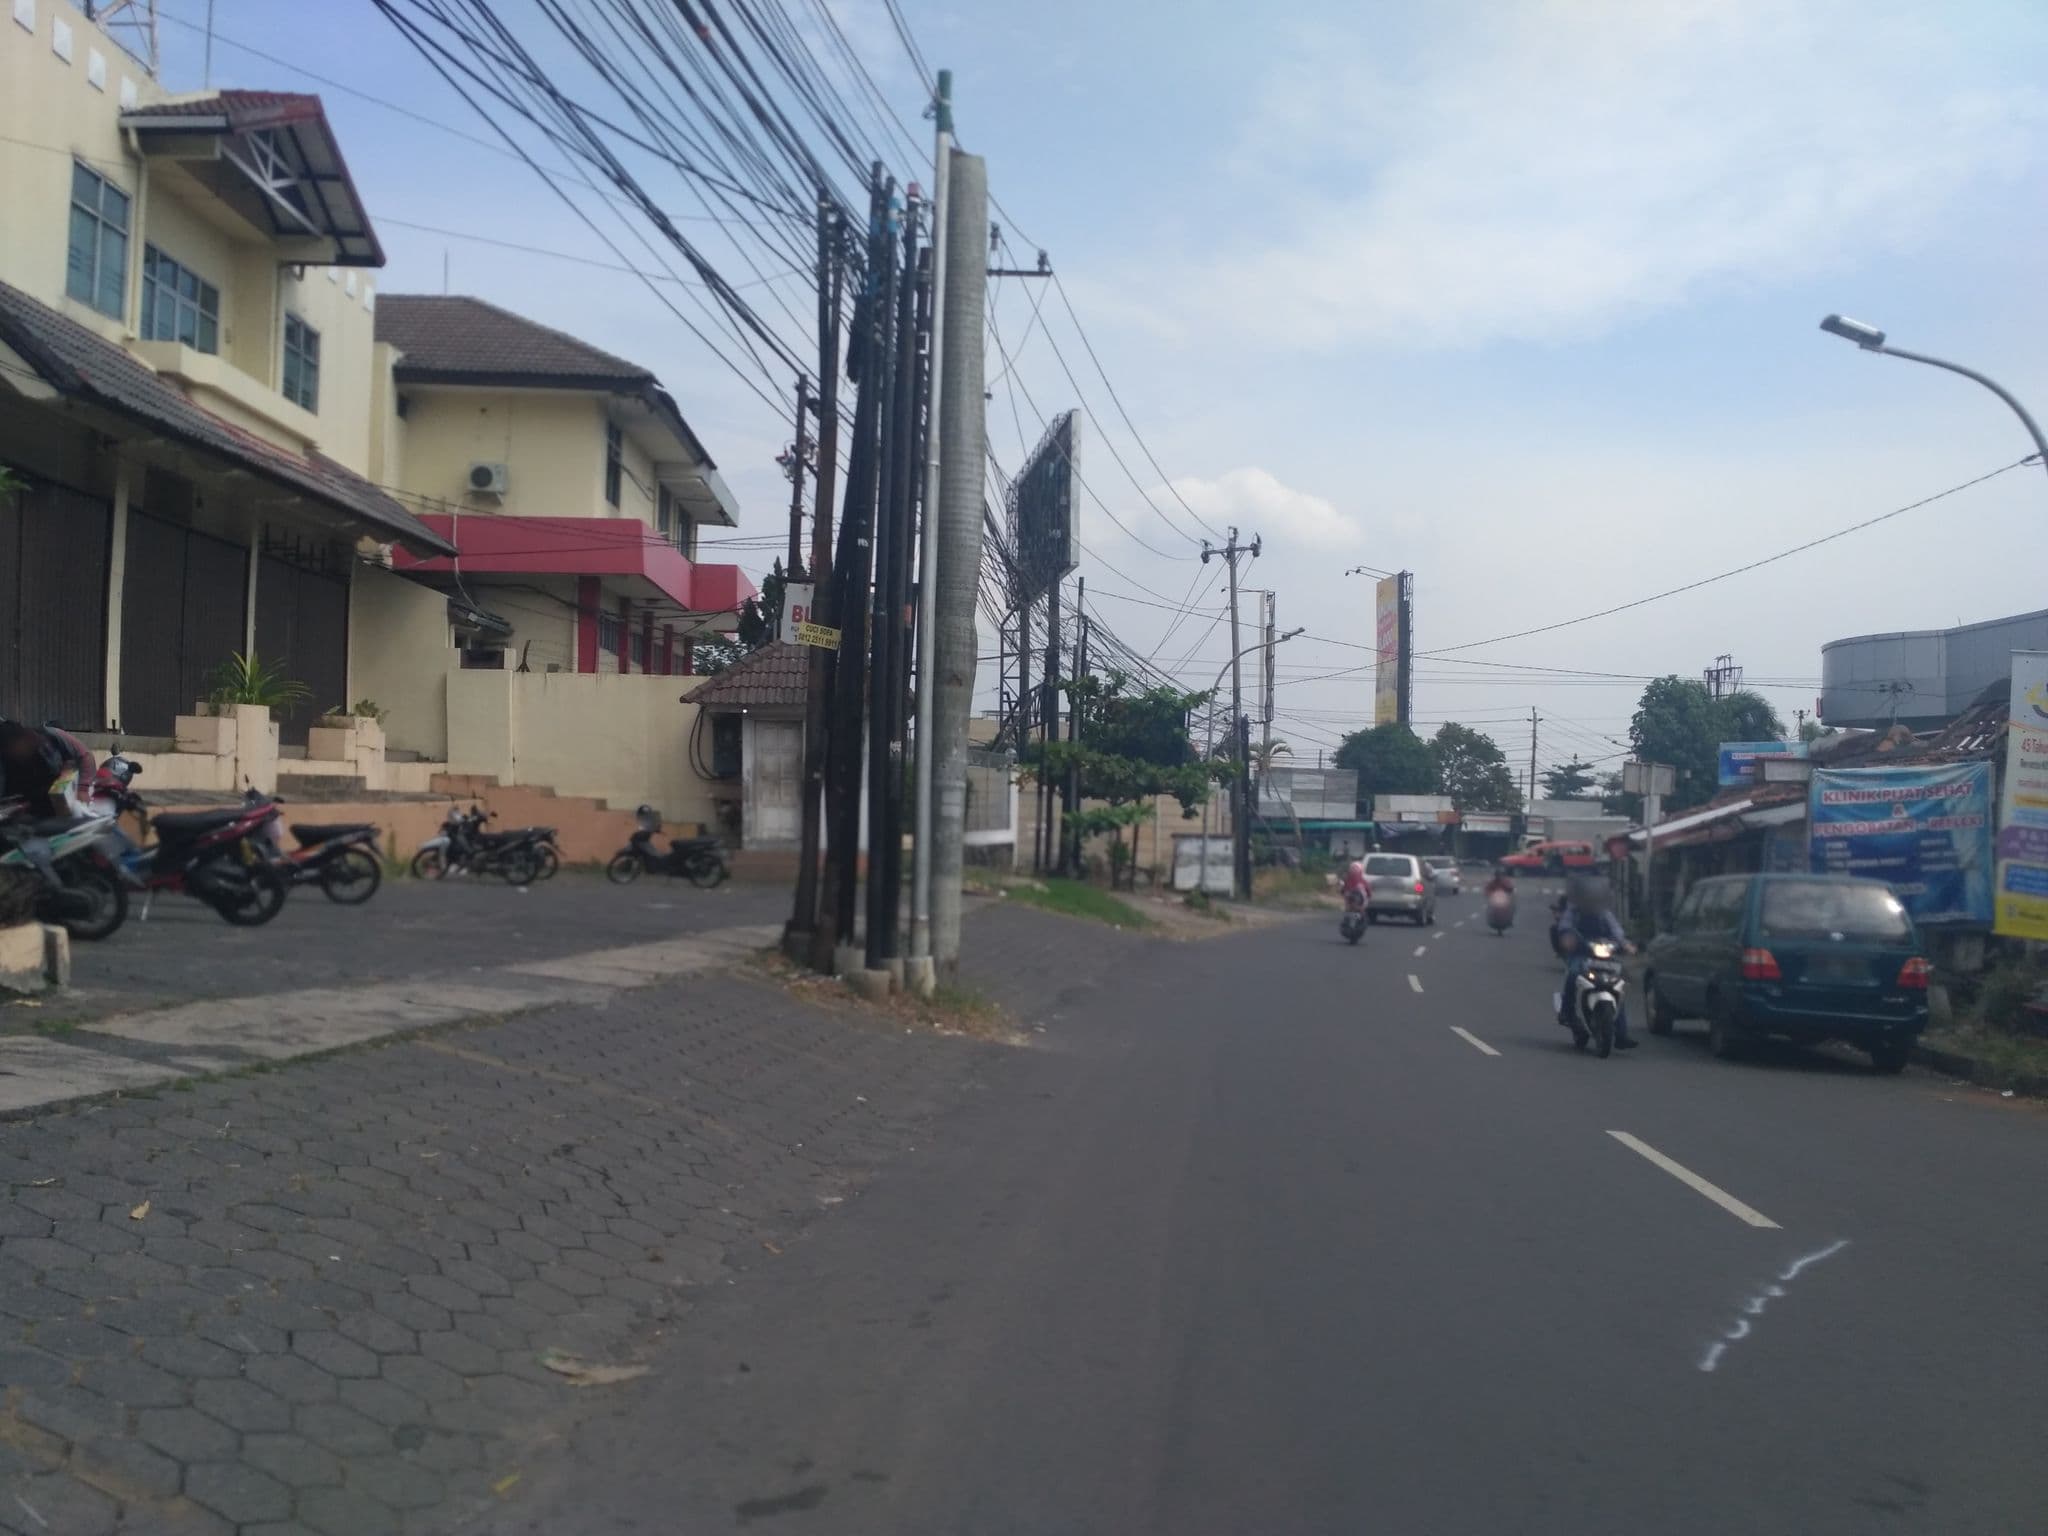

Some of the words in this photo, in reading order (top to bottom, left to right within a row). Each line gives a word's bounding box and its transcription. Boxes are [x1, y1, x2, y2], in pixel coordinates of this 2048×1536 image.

[1823, 790, 1879, 803] KLINIK
[1882, 787, 1922, 801] PIJAT
[1813, 820, 1916, 836] PENGOBATAN
